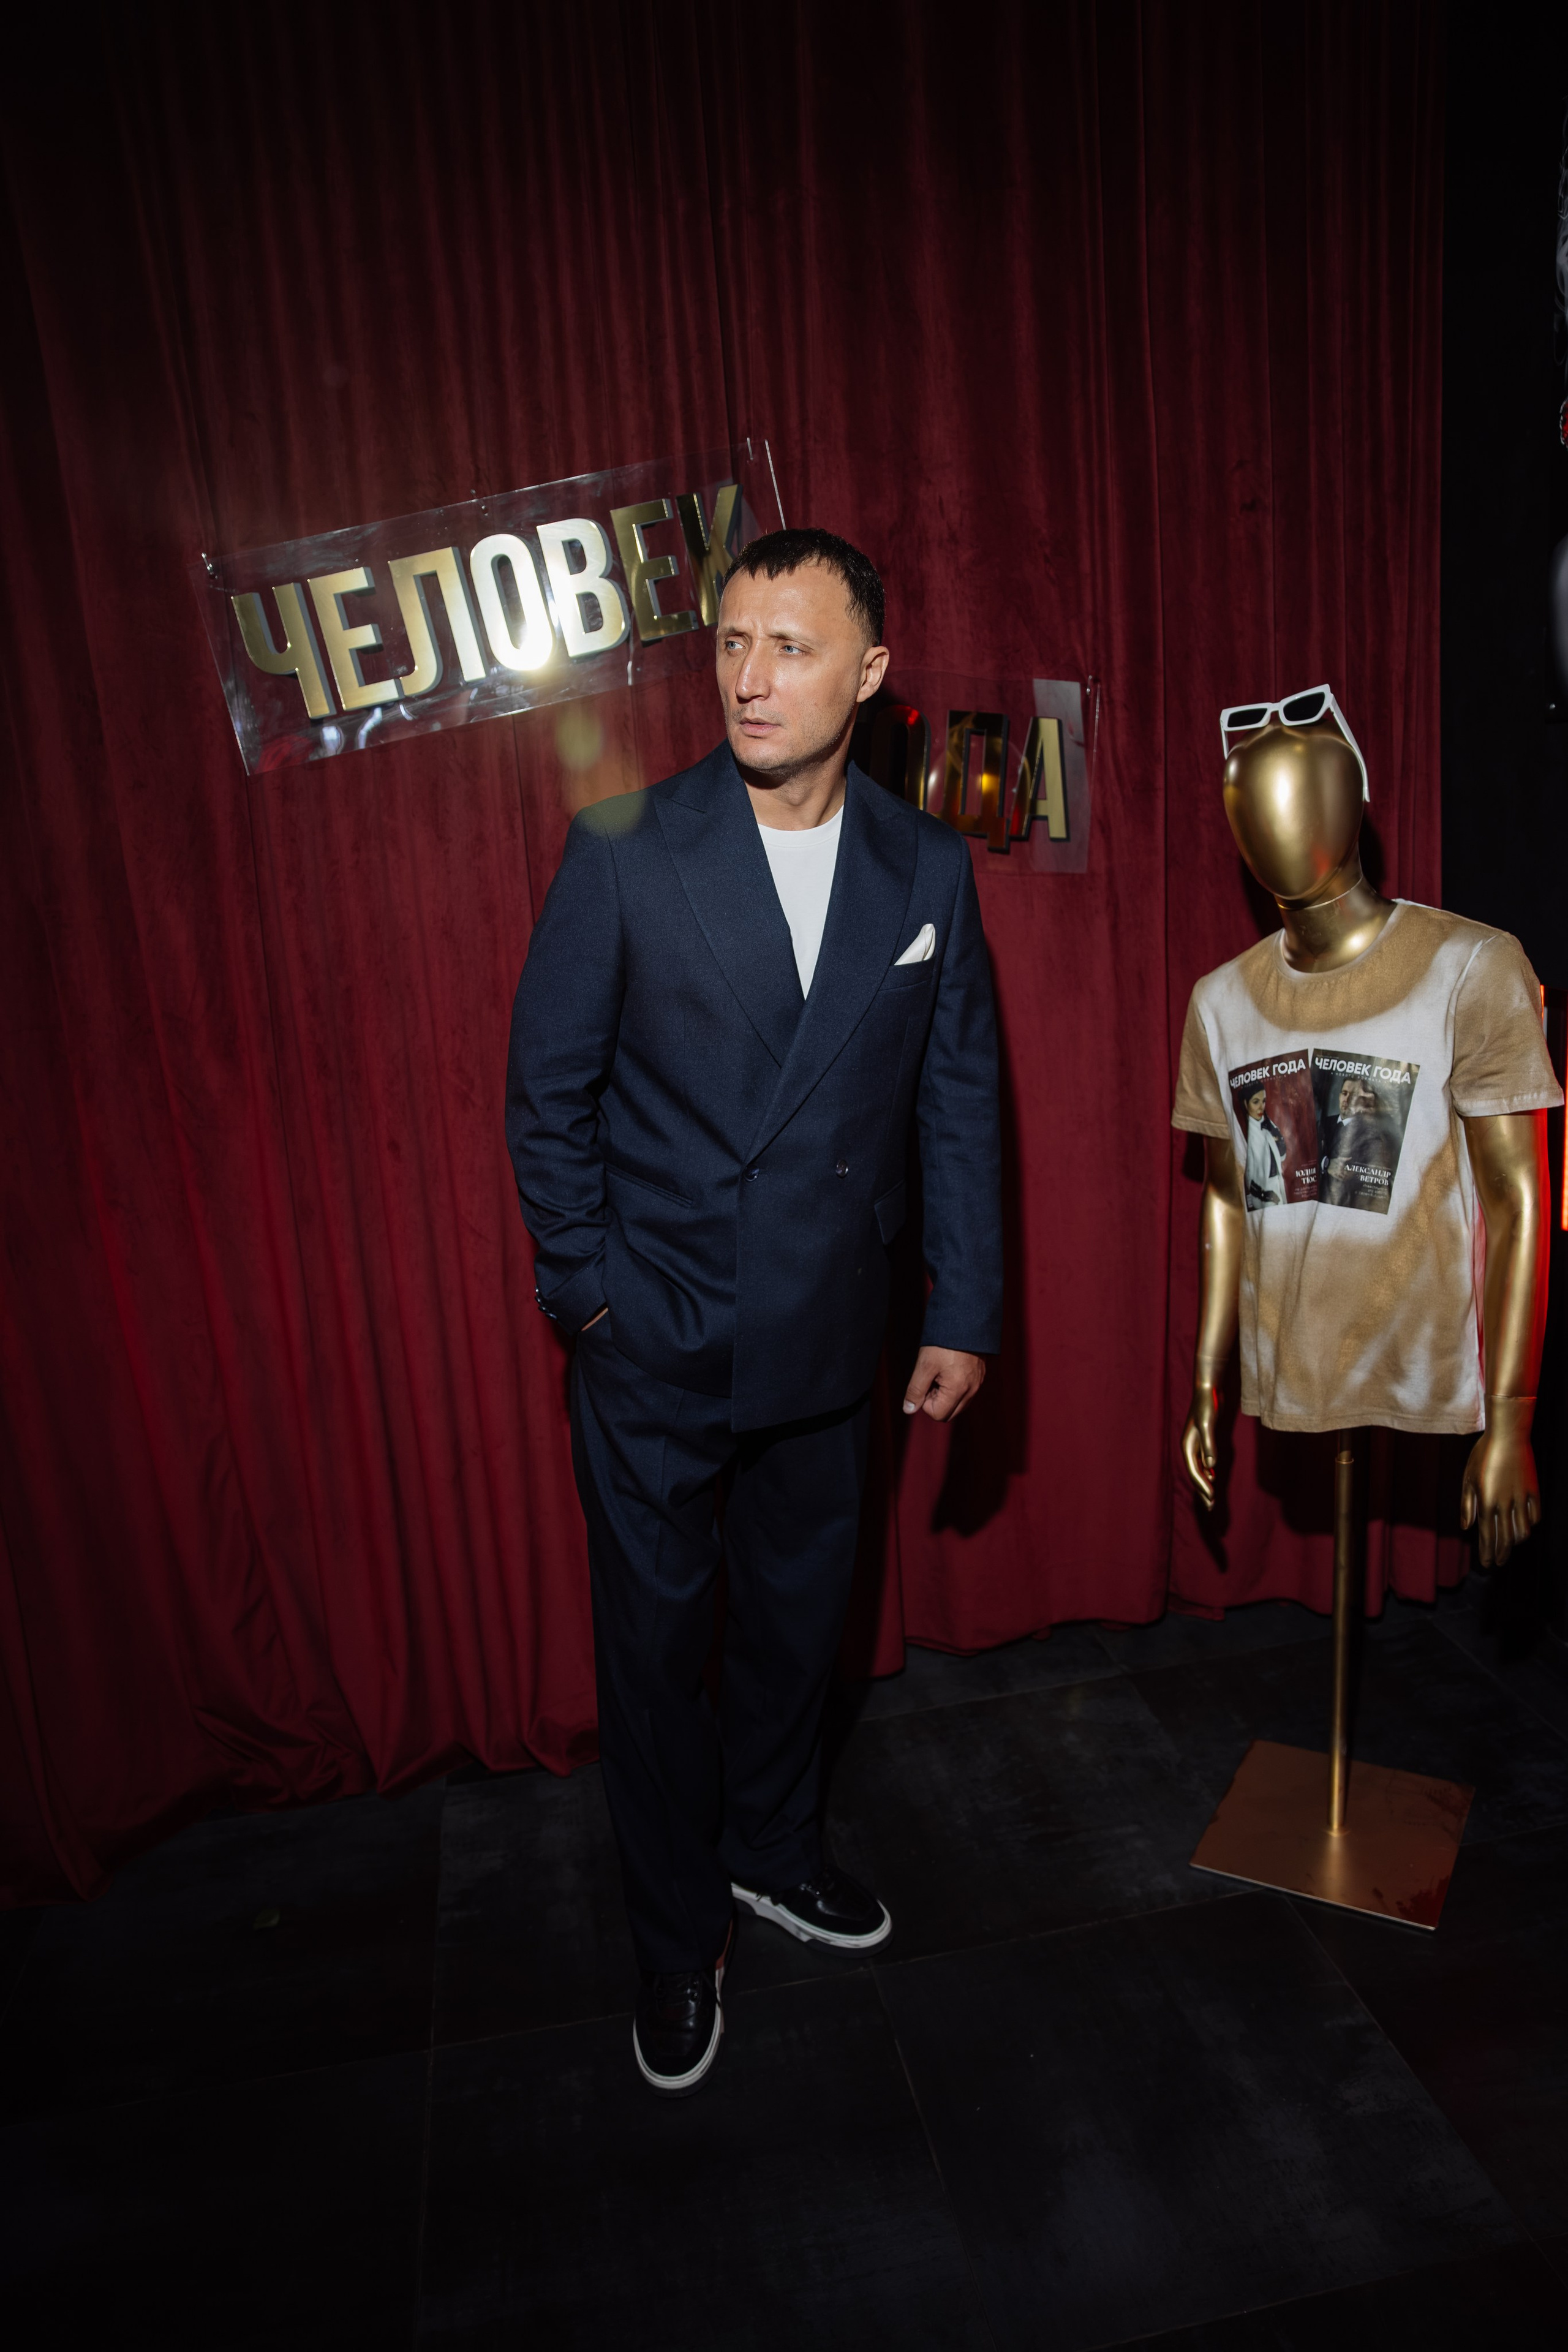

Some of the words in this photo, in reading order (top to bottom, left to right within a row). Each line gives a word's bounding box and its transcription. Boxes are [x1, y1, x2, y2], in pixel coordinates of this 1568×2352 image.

[231, 483, 743, 719] ЧЕЛОВЕК
[856, 704, 1070, 853] ОДА
[1230, 1065, 1270, 1088] ЧЕЛОВЕК
[1272, 1058, 1306, 1076] ГОДА
[1315, 1057, 1371, 1076] ЧЕЛОВЕК
[1373, 1065, 1411, 1084] ГОДА
[1344, 1164, 1392, 1178] АЛЕКСАНДР
[1360, 1174, 1389, 1186] ВЕТРОВ
